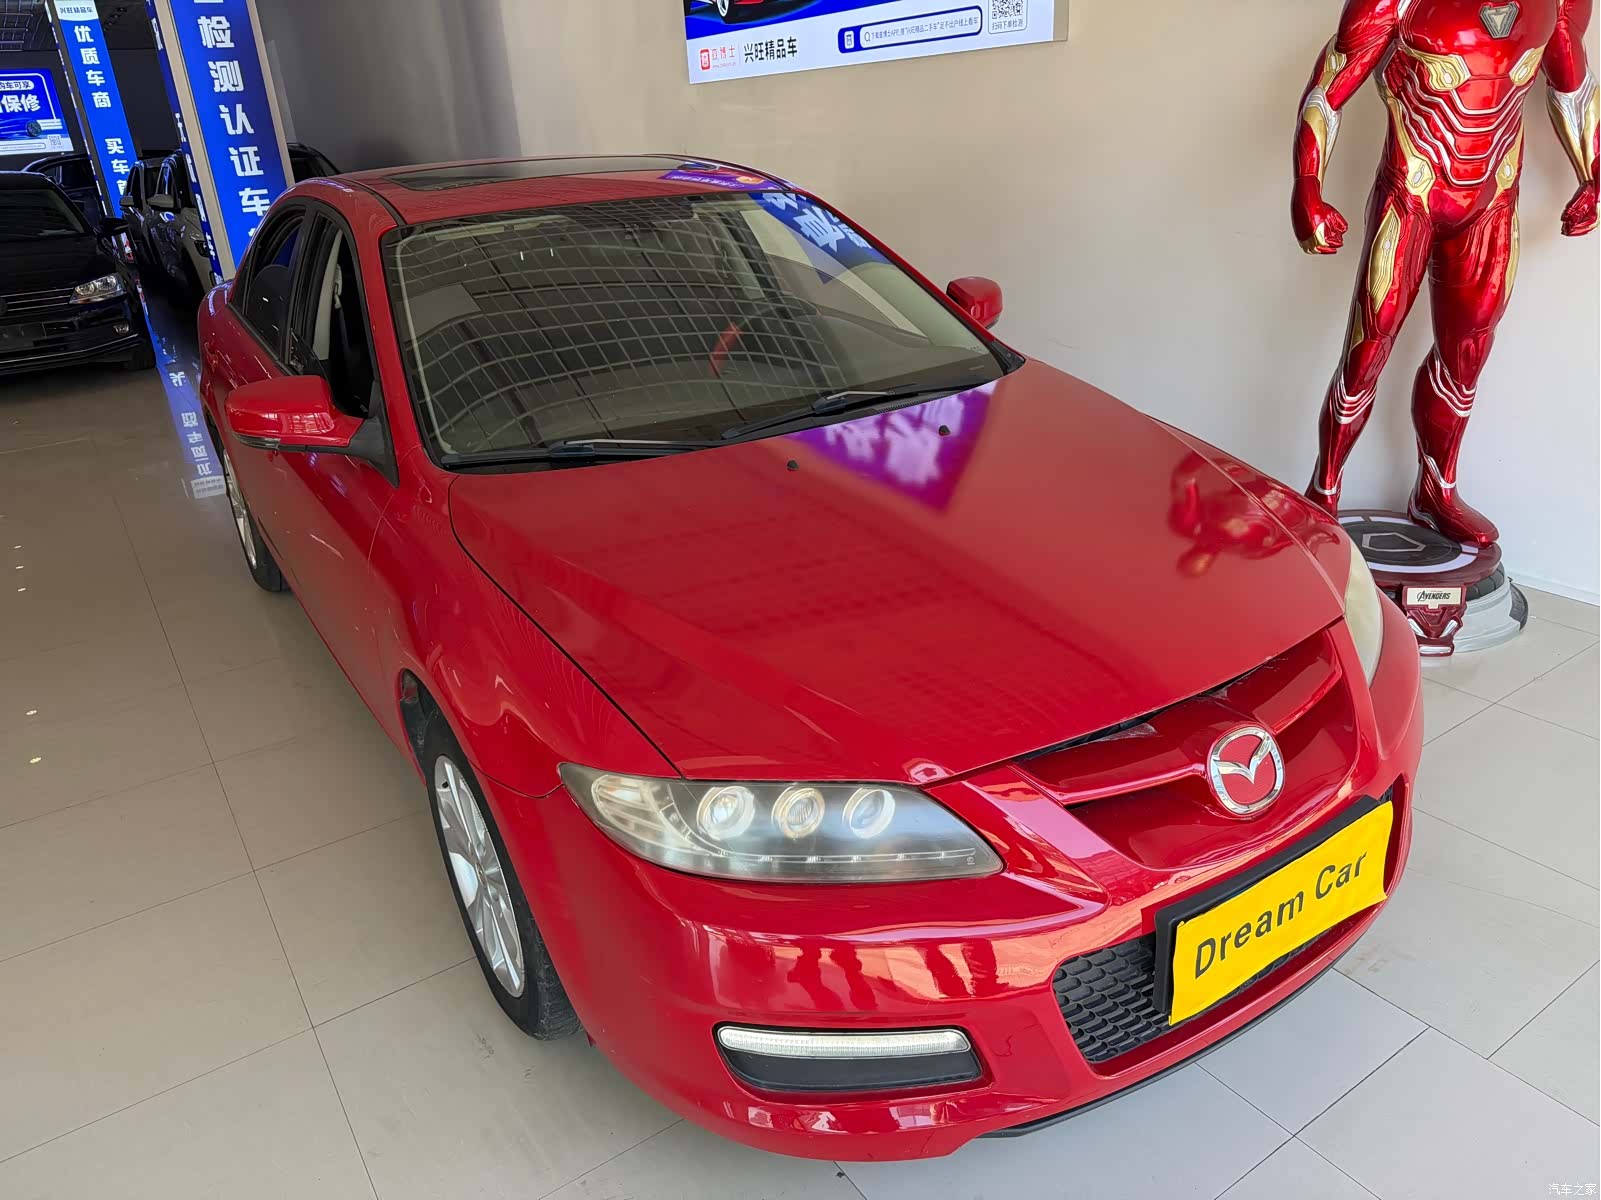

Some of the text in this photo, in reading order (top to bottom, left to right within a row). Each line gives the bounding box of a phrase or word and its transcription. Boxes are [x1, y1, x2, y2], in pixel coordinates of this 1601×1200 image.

[73, 25, 112, 109] 优质车商
[743, 36, 798, 63] 兴旺精品车
[0, 93, 41, 113] 保修
[193, 0, 271, 237] 检测认证车
[1416, 590, 1451, 602] AVENGERS
[1194, 851, 1368, 980] Dream Car
